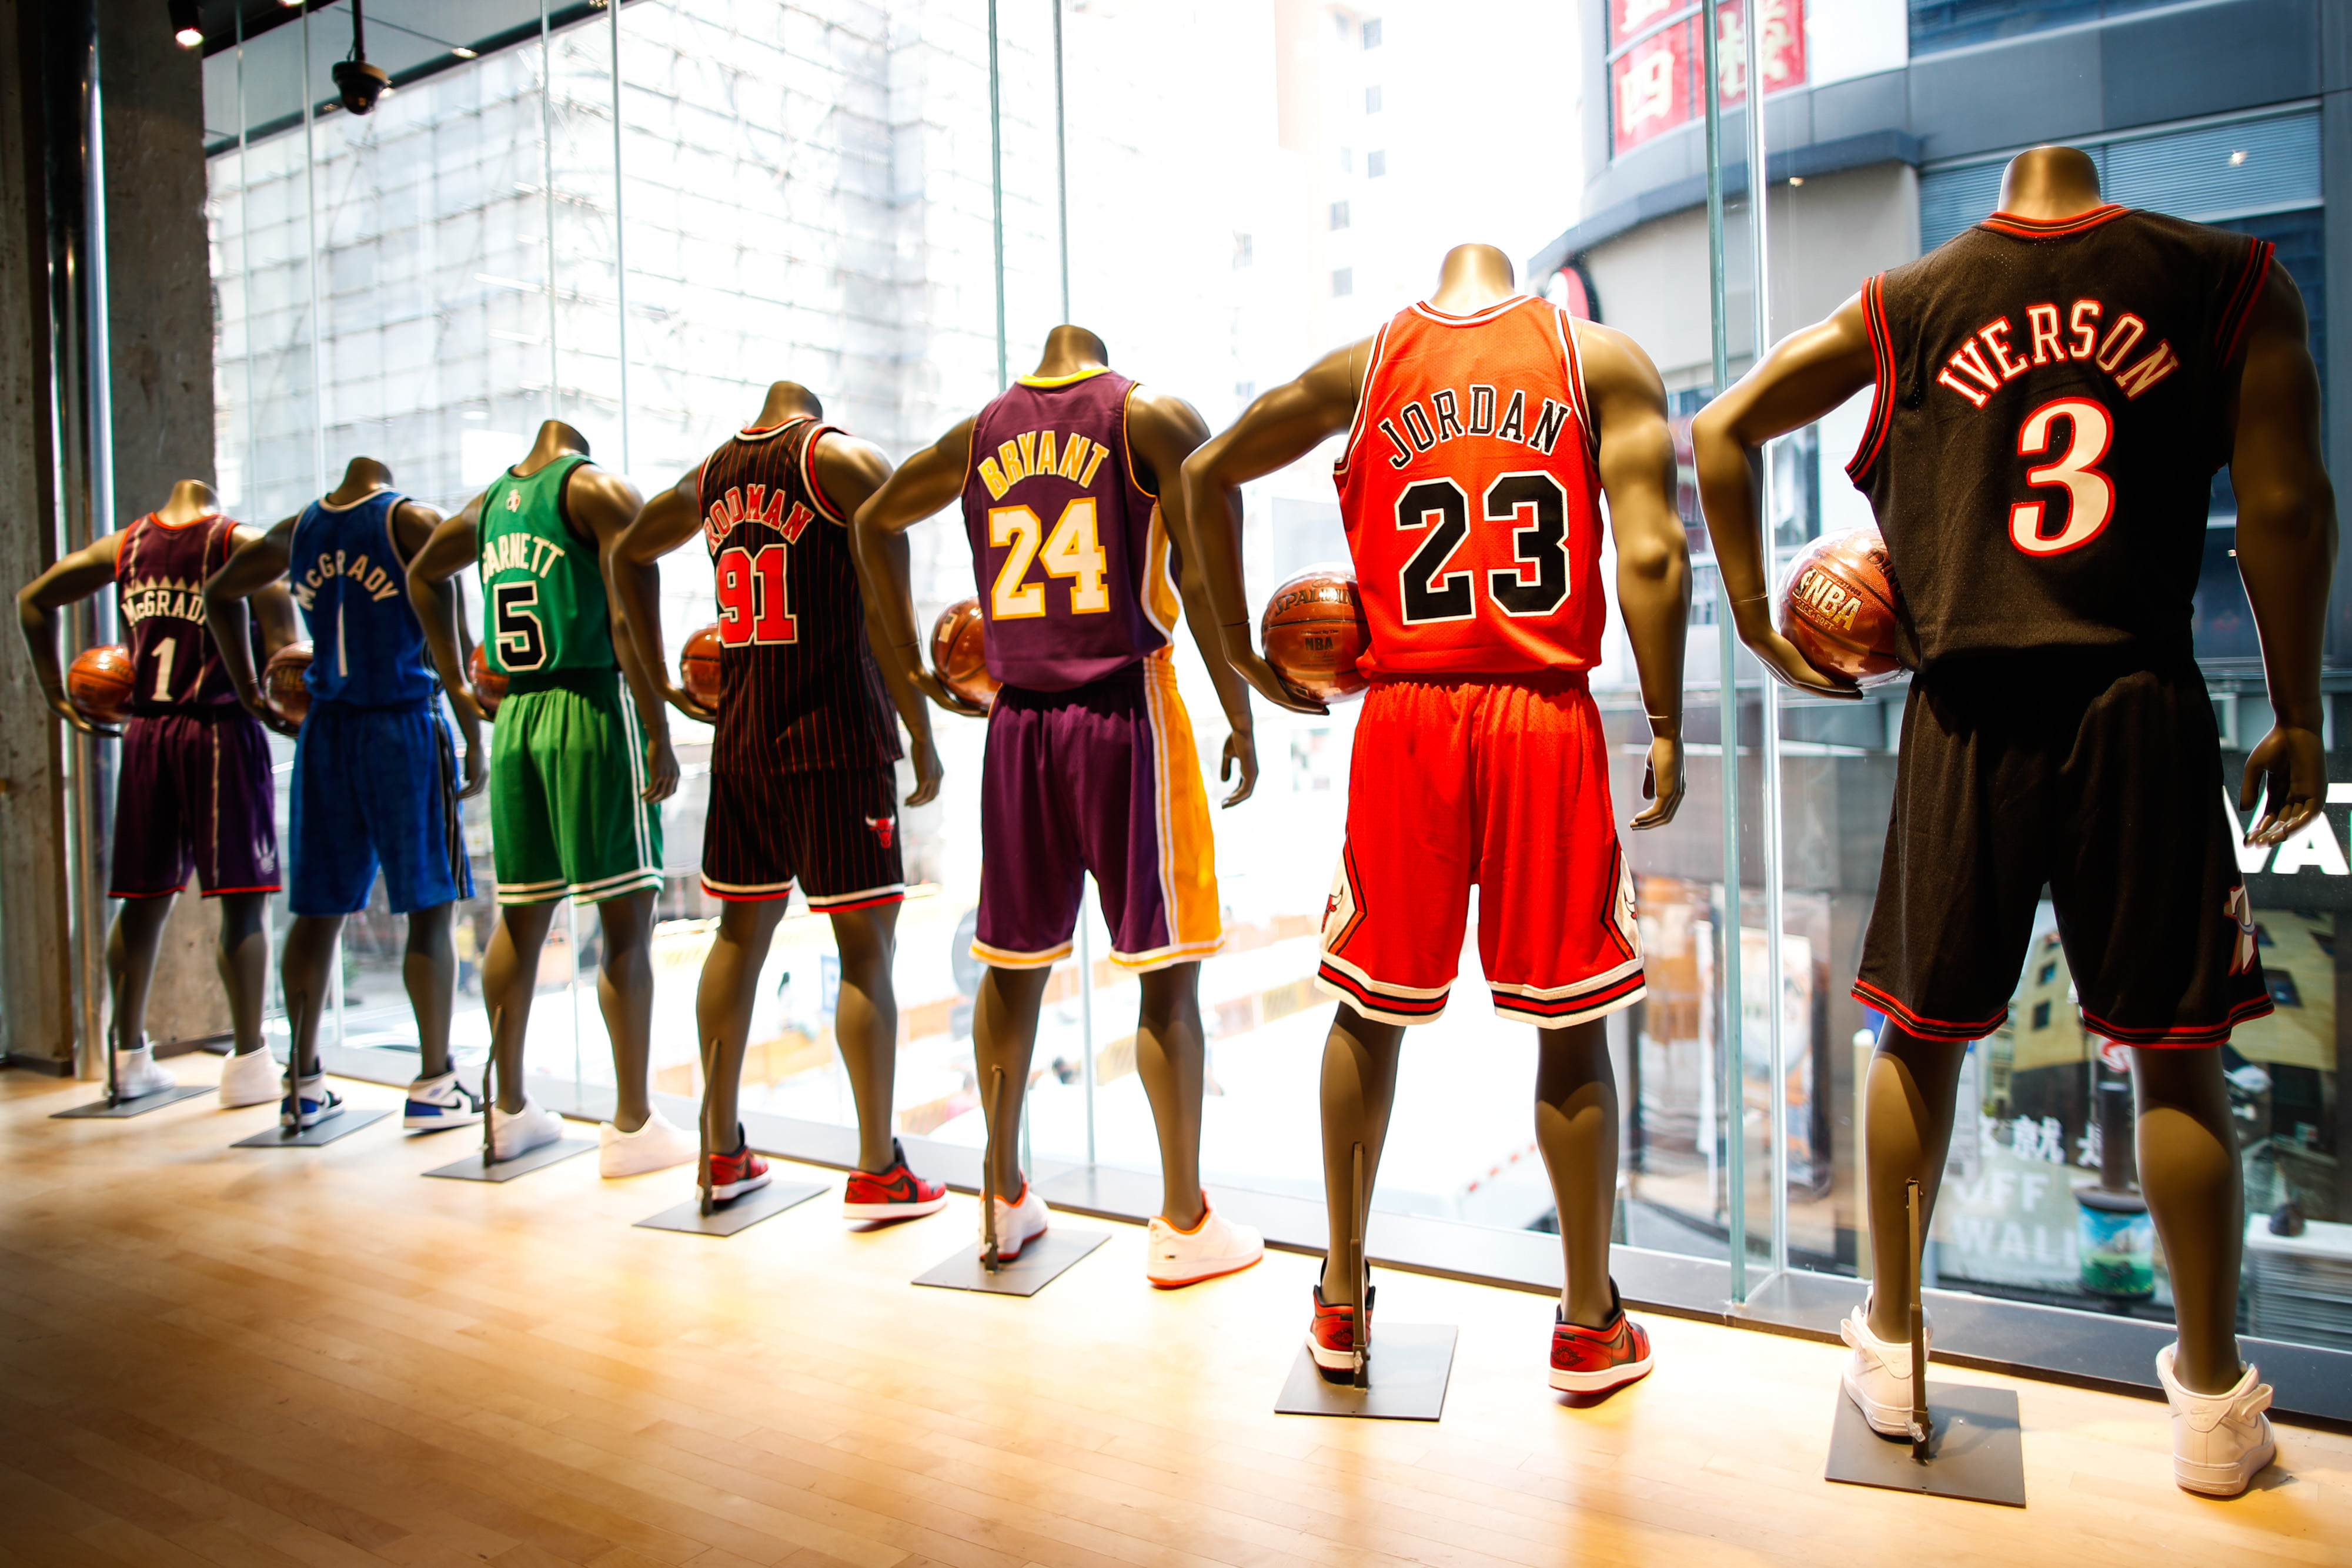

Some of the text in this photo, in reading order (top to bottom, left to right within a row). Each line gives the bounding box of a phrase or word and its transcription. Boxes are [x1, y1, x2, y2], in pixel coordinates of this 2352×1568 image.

[1936, 299, 2180, 408] IVERSON
[978, 430, 1110, 502] BRYANT
[1378, 384, 1572, 470] JORDAN
[704, 484, 815, 556] RODMAN
[2009, 397, 2115, 557] 3
[988, 497, 1110, 621] 24
[1394, 470, 1571, 626] 23
[337, 601, 348, 677] 1
[493, 580, 546, 673] 5
[716, 544, 799, 648] 91
[1803, 574, 1862, 631] NBA
[151, 637, 176, 702] 1
[1305, 637, 1334, 651] NBA
[2222, 783, 2352, 875] VA
